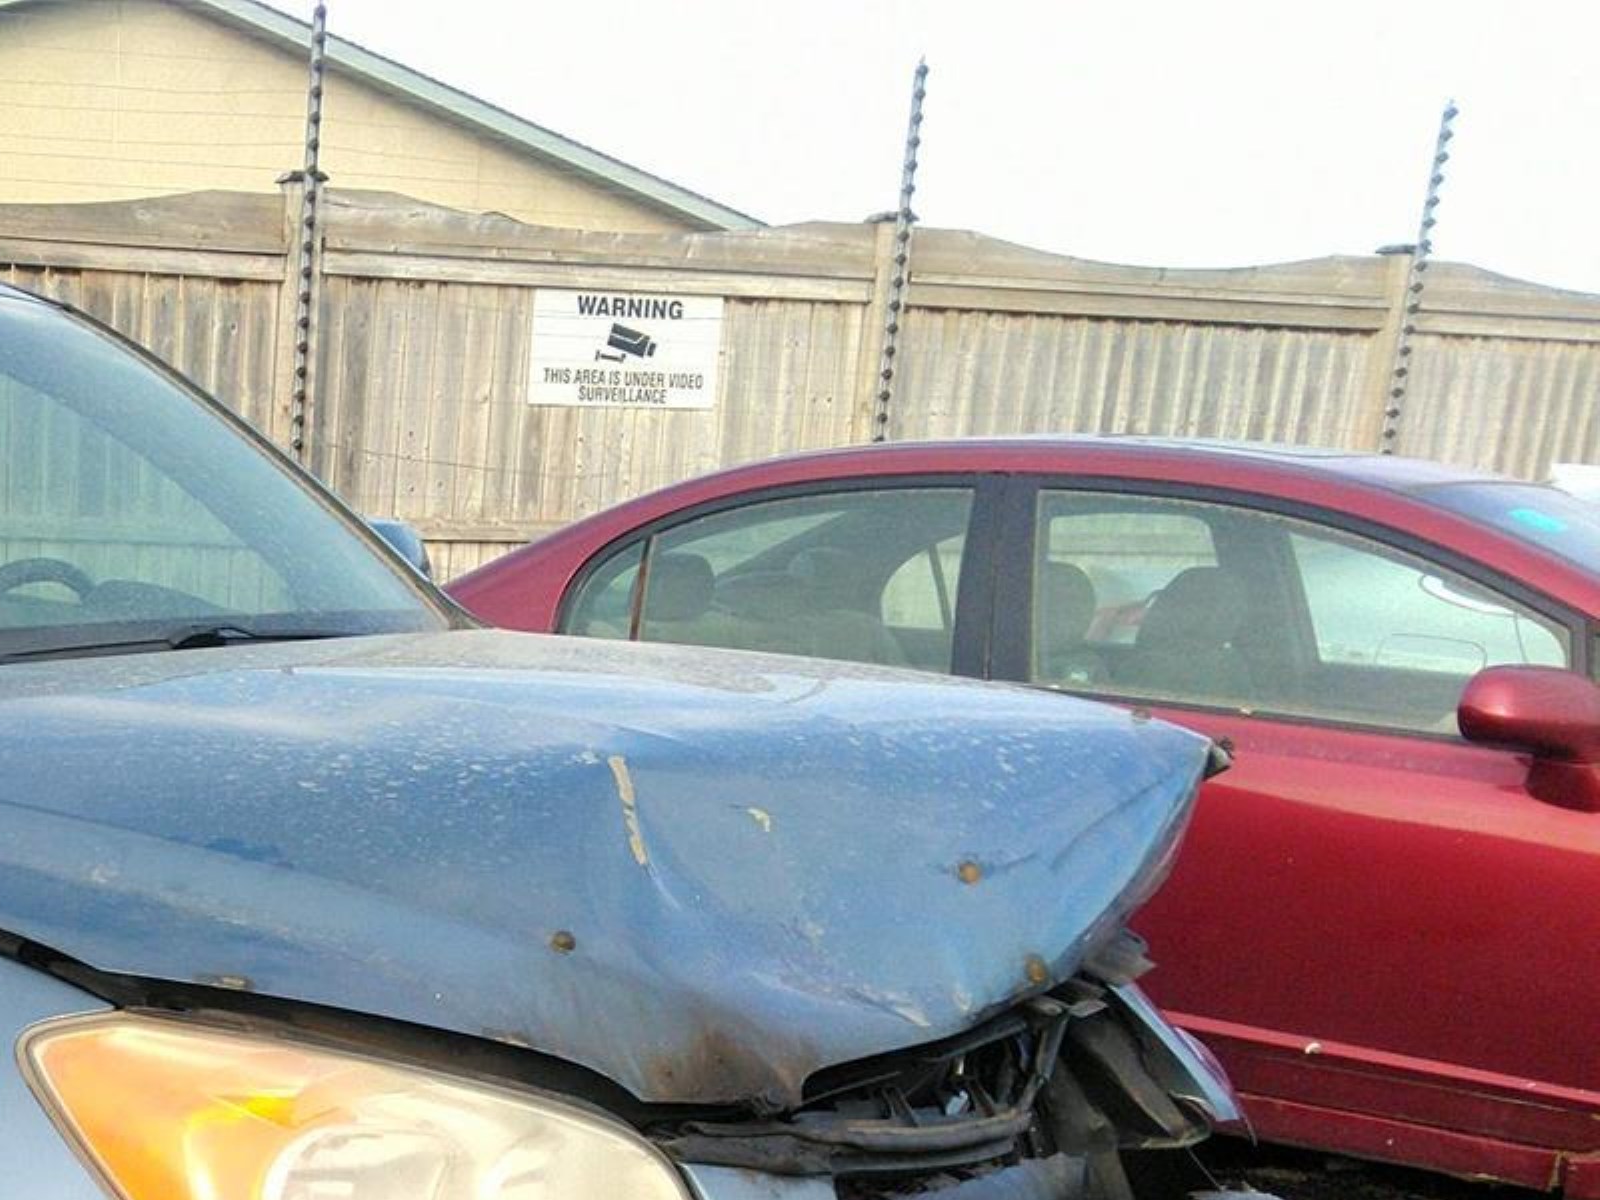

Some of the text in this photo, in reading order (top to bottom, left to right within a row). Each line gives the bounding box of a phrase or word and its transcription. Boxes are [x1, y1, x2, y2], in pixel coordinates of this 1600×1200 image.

[577, 295, 684, 319] WARNING
[543, 367, 703, 389] THIS AREA IS UNDER VIDEO
[577, 385, 667, 404] SURVEILLANCE
